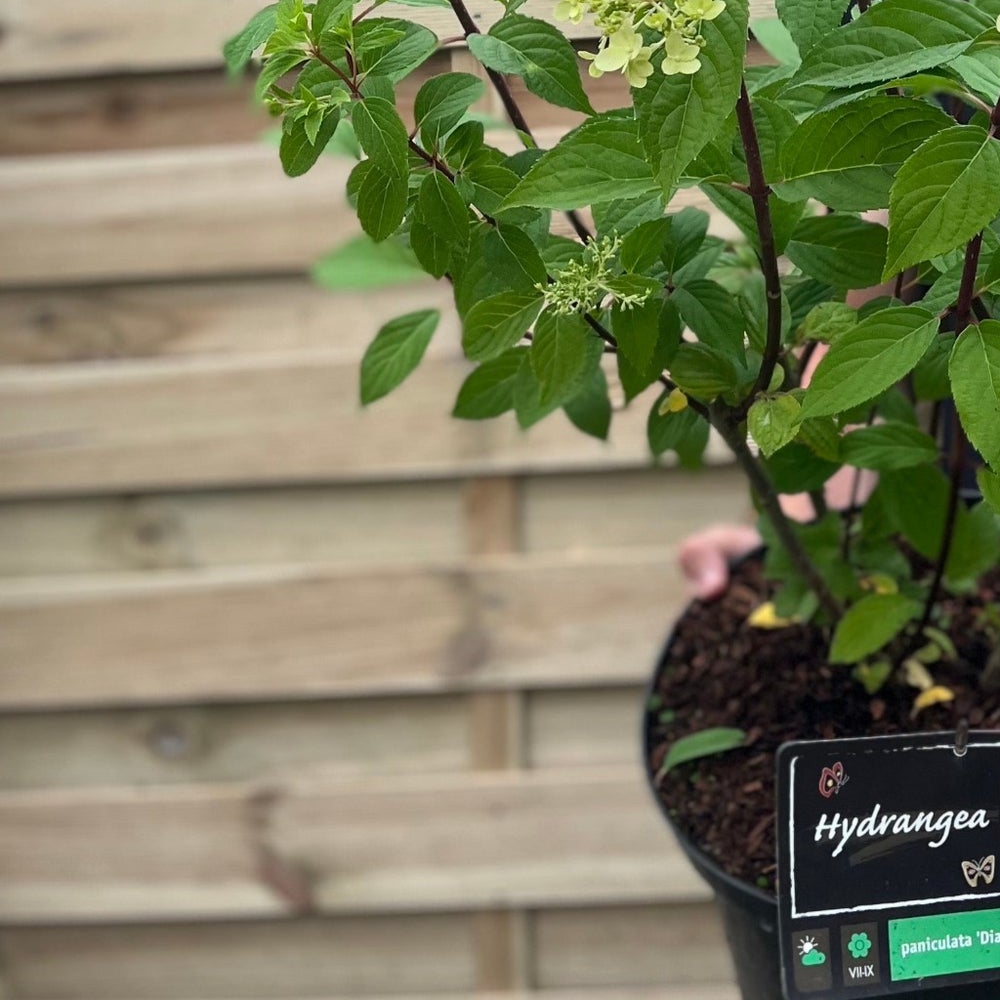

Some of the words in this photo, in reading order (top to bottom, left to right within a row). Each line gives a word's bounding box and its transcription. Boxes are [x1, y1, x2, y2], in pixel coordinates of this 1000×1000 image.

[814, 803, 990, 857] Hydrangea
[901, 934, 972, 958] paniculata
[848, 964, 875, 979] VII-IX
